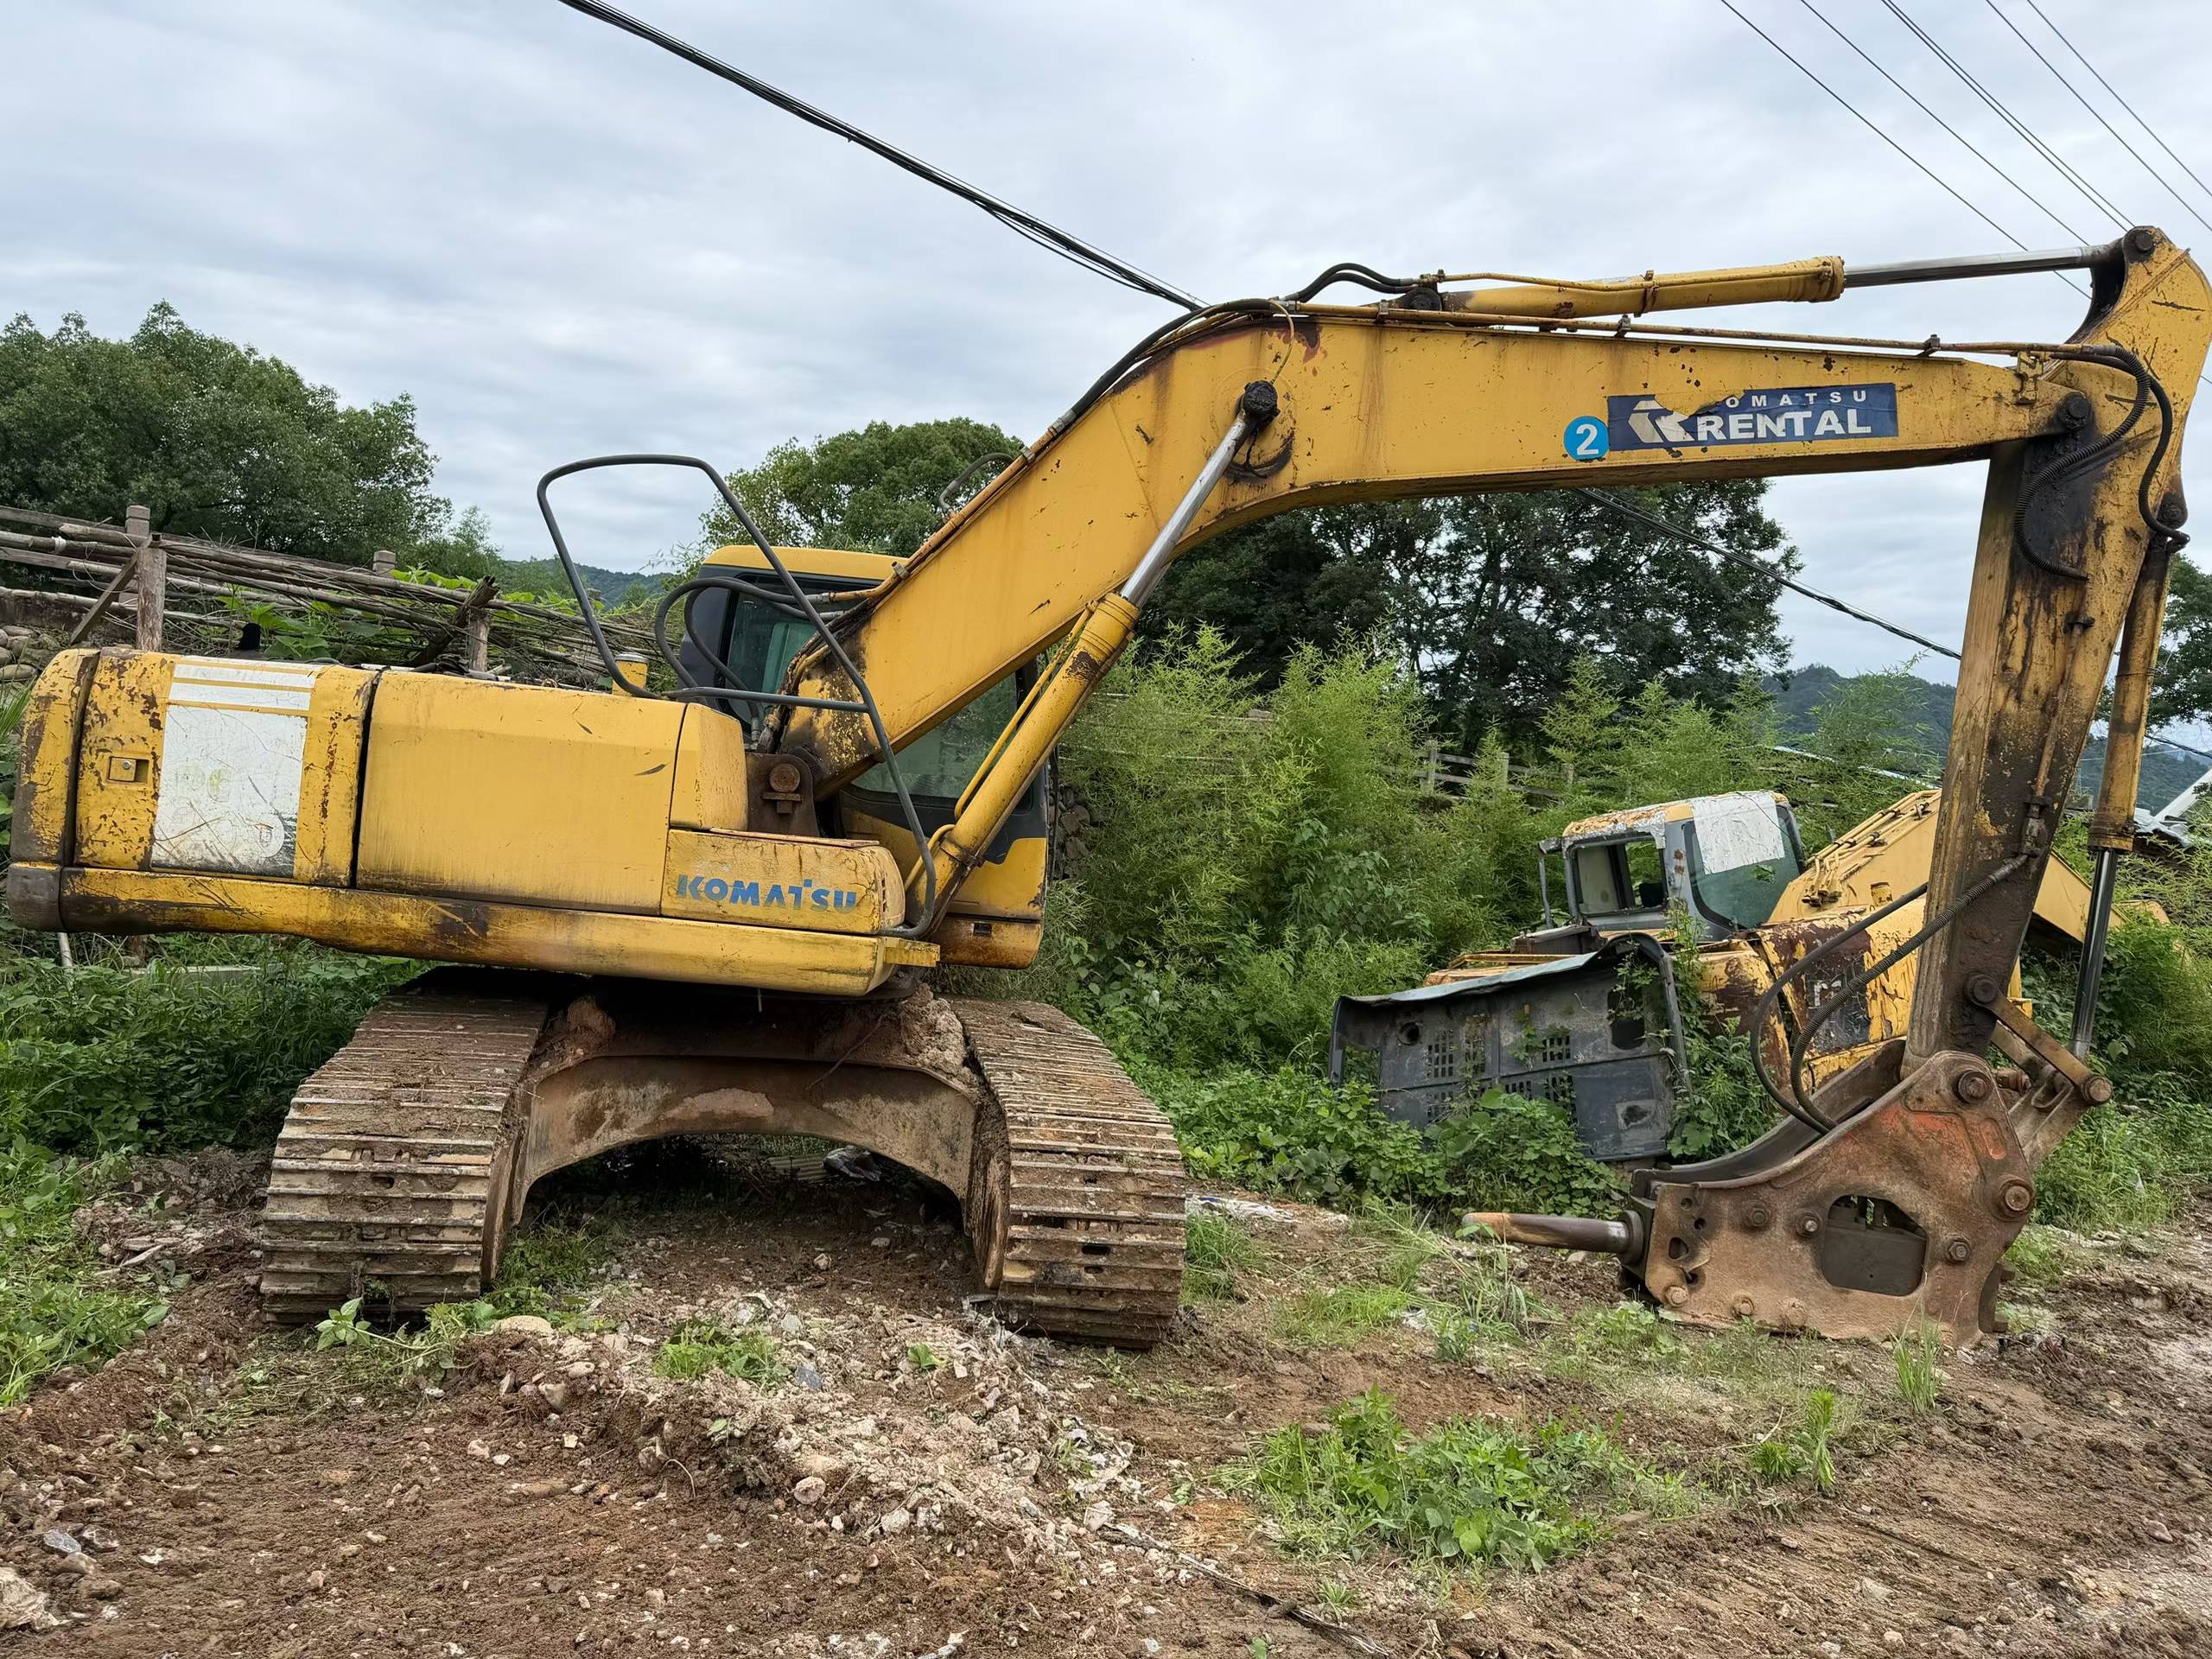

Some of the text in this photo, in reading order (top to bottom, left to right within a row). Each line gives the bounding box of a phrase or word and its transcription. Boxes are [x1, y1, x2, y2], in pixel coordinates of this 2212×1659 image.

[1725, 390, 1867, 409] OMATSU
[1575, 423, 1599, 456] 2
[1696, 409, 1872, 442] RENTAL
[677, 875, 857, 913] KOMATSU
